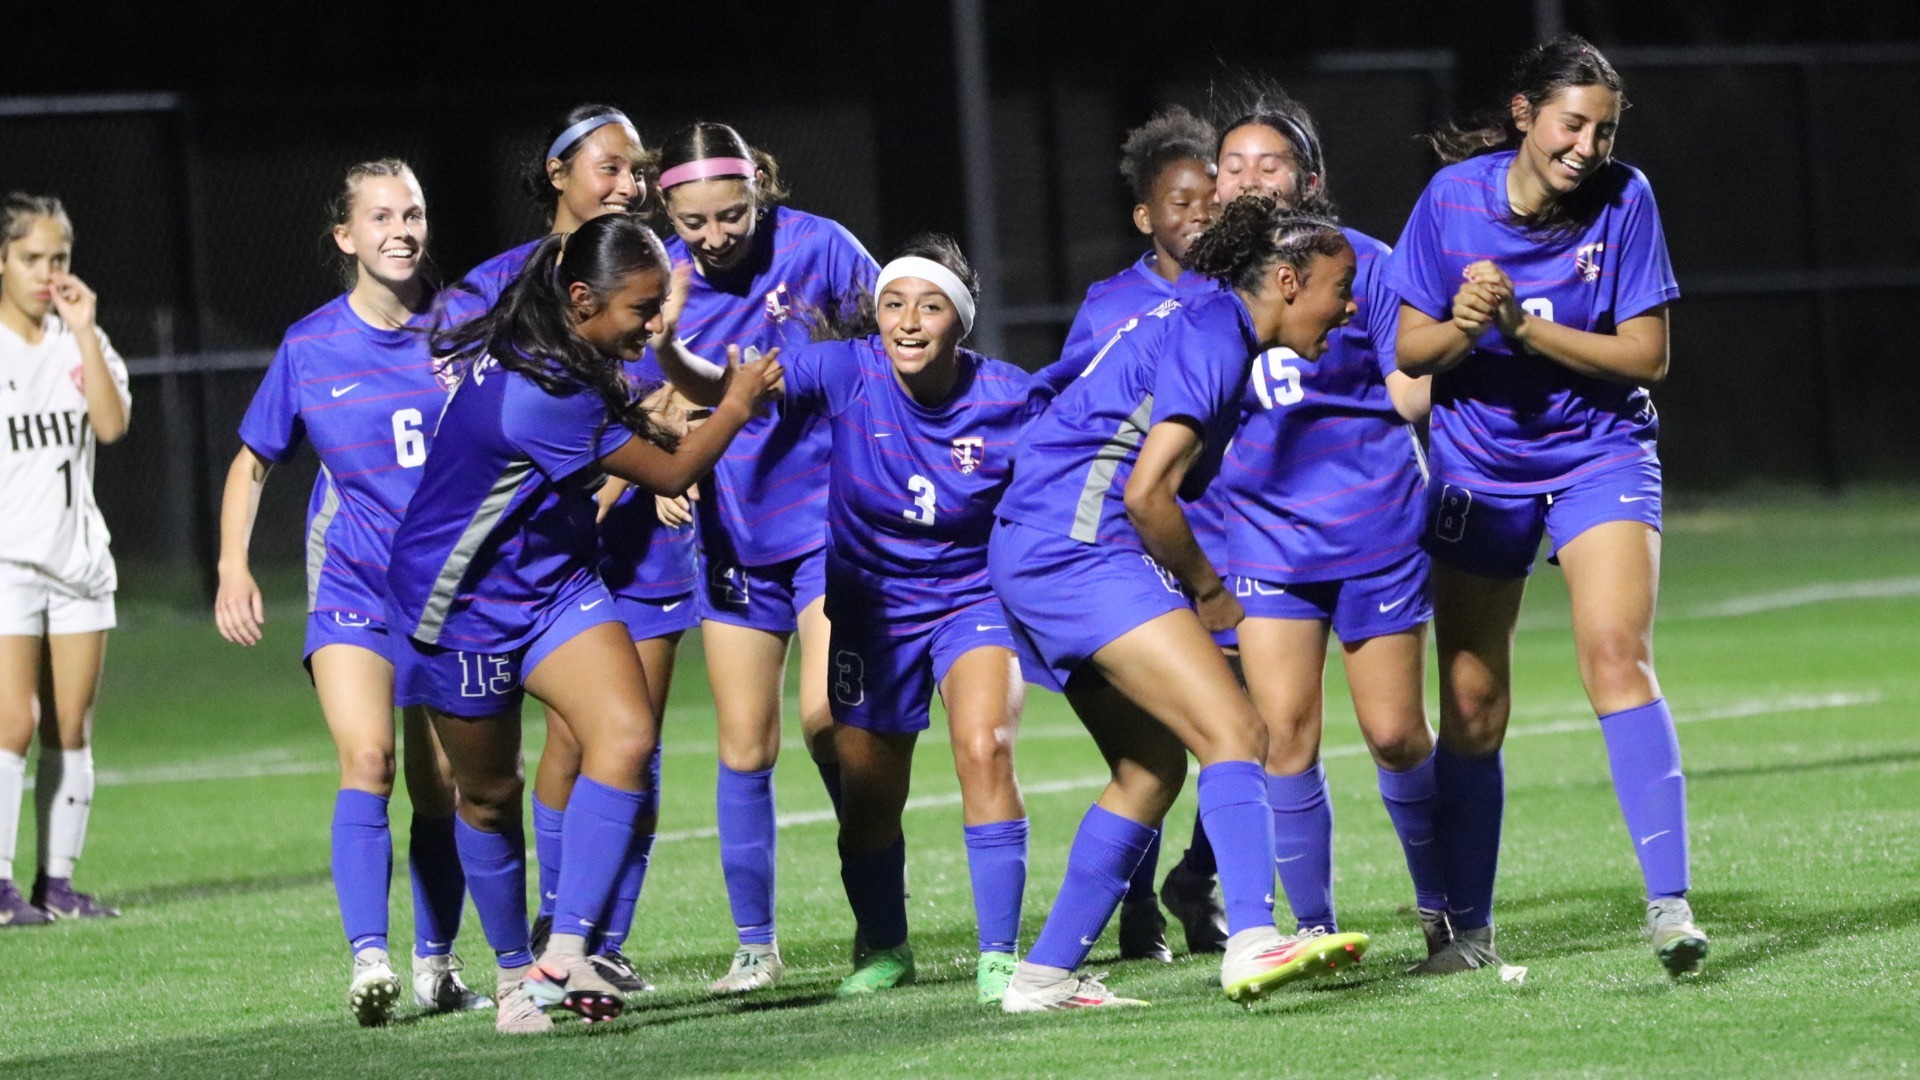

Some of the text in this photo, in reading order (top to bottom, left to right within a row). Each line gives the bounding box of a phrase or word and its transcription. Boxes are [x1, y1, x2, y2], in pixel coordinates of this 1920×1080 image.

[1252, 346, 1304, 410] 15
[391, 408, 427, 469] 6
[57, 459, 72, 508] 1
[903, 474, 936, 526] 3
[1436, 484, 1472, 543] 8
[835, 650, 864, 706] 3
